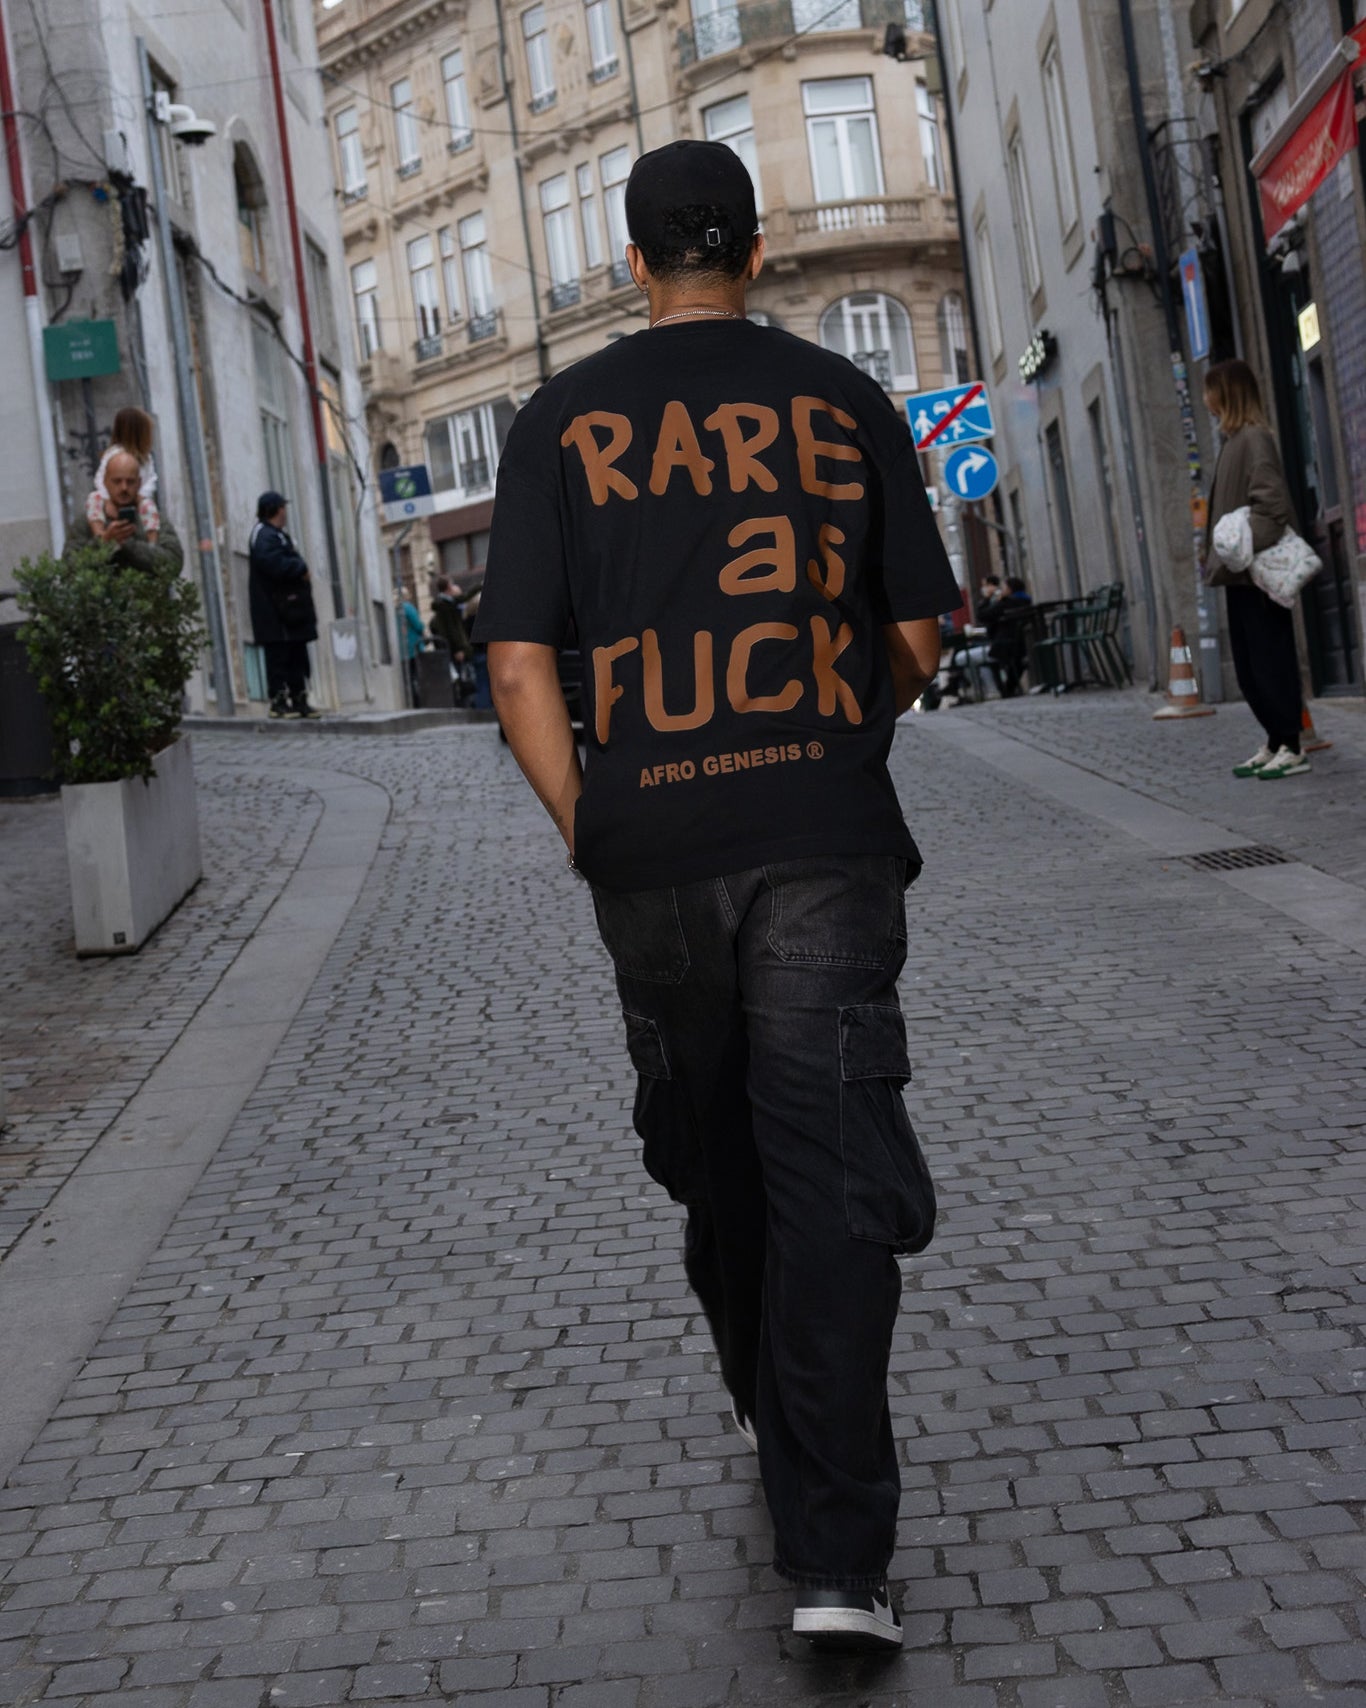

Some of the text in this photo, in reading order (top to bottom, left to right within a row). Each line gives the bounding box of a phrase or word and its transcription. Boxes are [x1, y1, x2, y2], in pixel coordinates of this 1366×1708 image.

[561, 396, 864, 506] RARE
[719, 515, 845, 600] as
[592, 615, 862, 744] FUCK
[639, 761, 696, 788] AFRO
[703, 744, 802, 776] GENESIS
